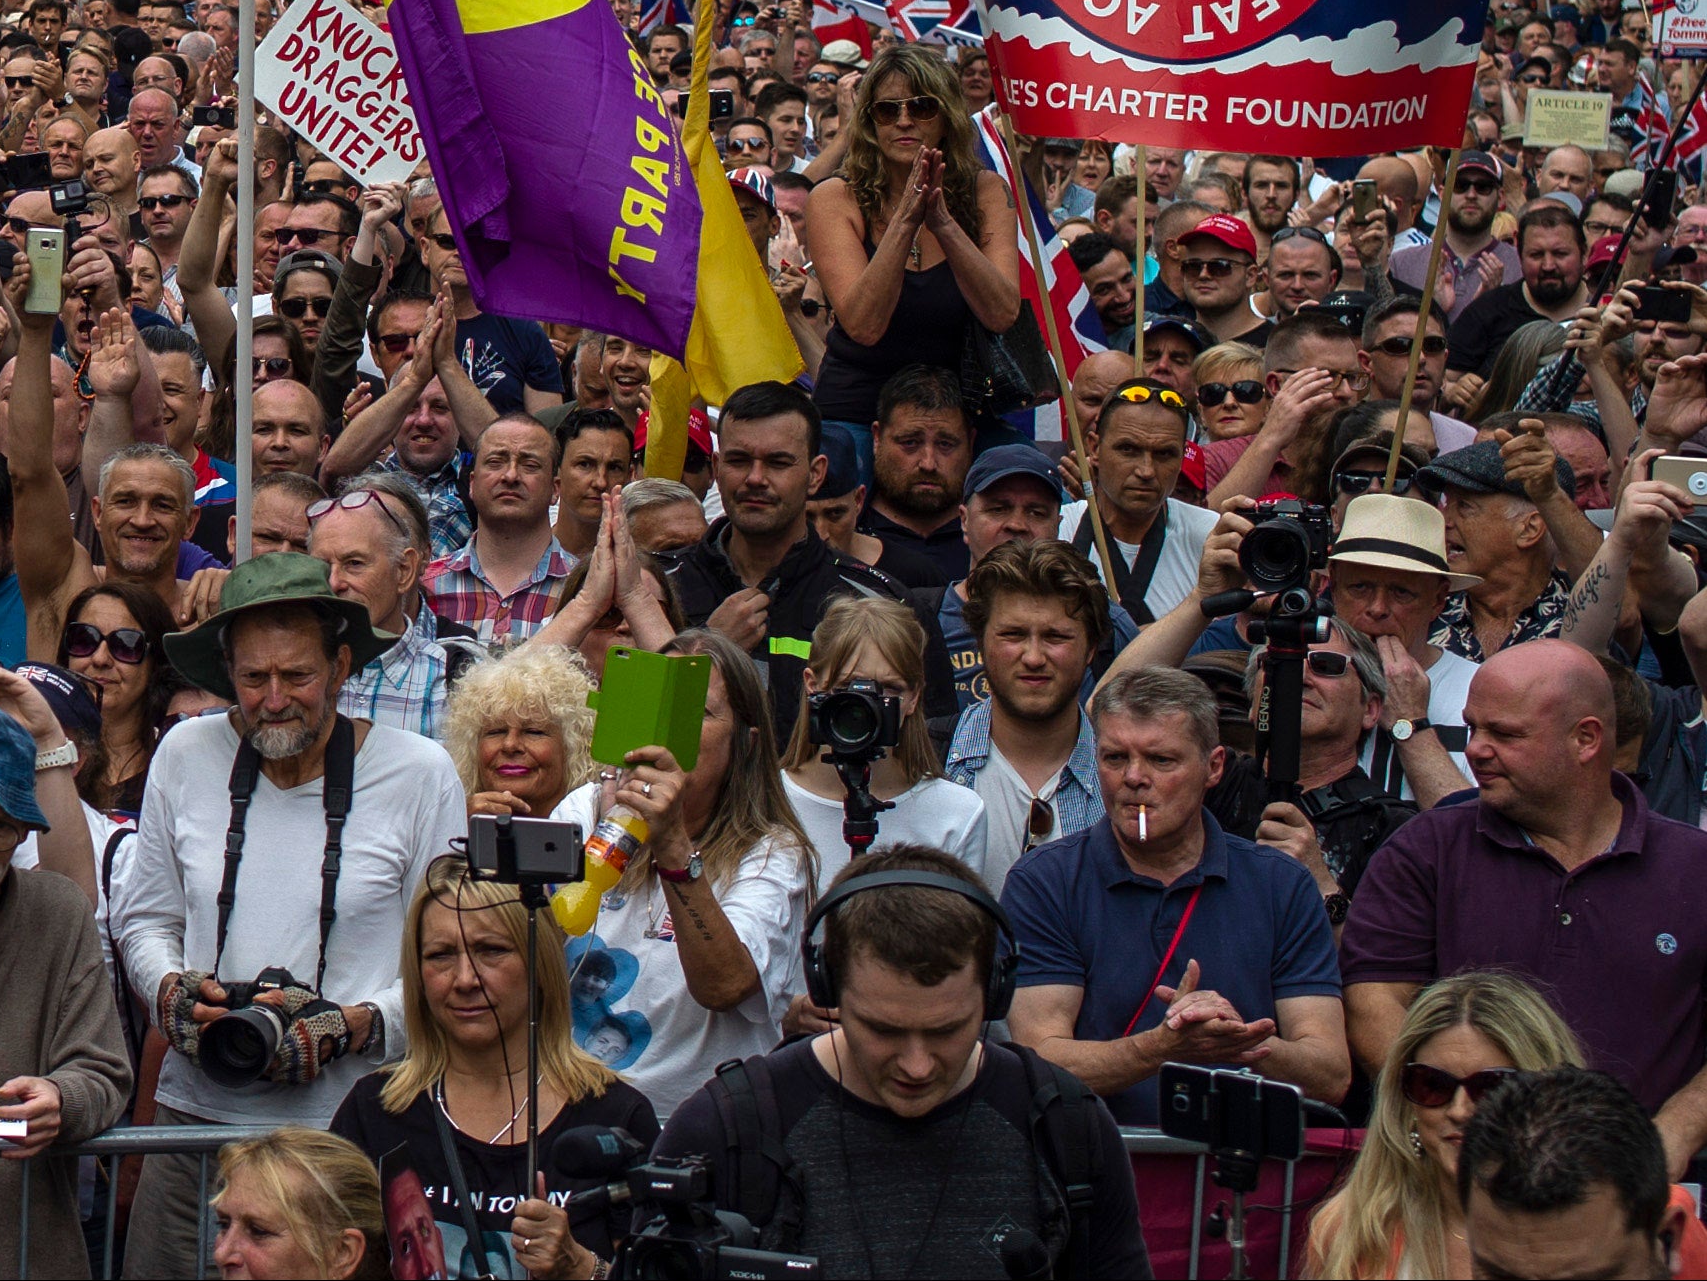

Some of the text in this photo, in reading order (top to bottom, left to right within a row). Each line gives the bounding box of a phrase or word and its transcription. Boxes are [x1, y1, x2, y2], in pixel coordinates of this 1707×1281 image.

[1672, 17, 1707, 27] #Free
[275, 33, 424, 162] DRAGGERS
[1046, 82, 1209, 122] CHARTER
[1226, 94, 1429, 129] FOUNDATION
[1535, 98, 1604, 111] ARTICLE 19
[278, 81, 387, 176] UNITE!
[1258, 686, 1270, 732] BENRO
[787, 1261, 812, 1269] SONY
